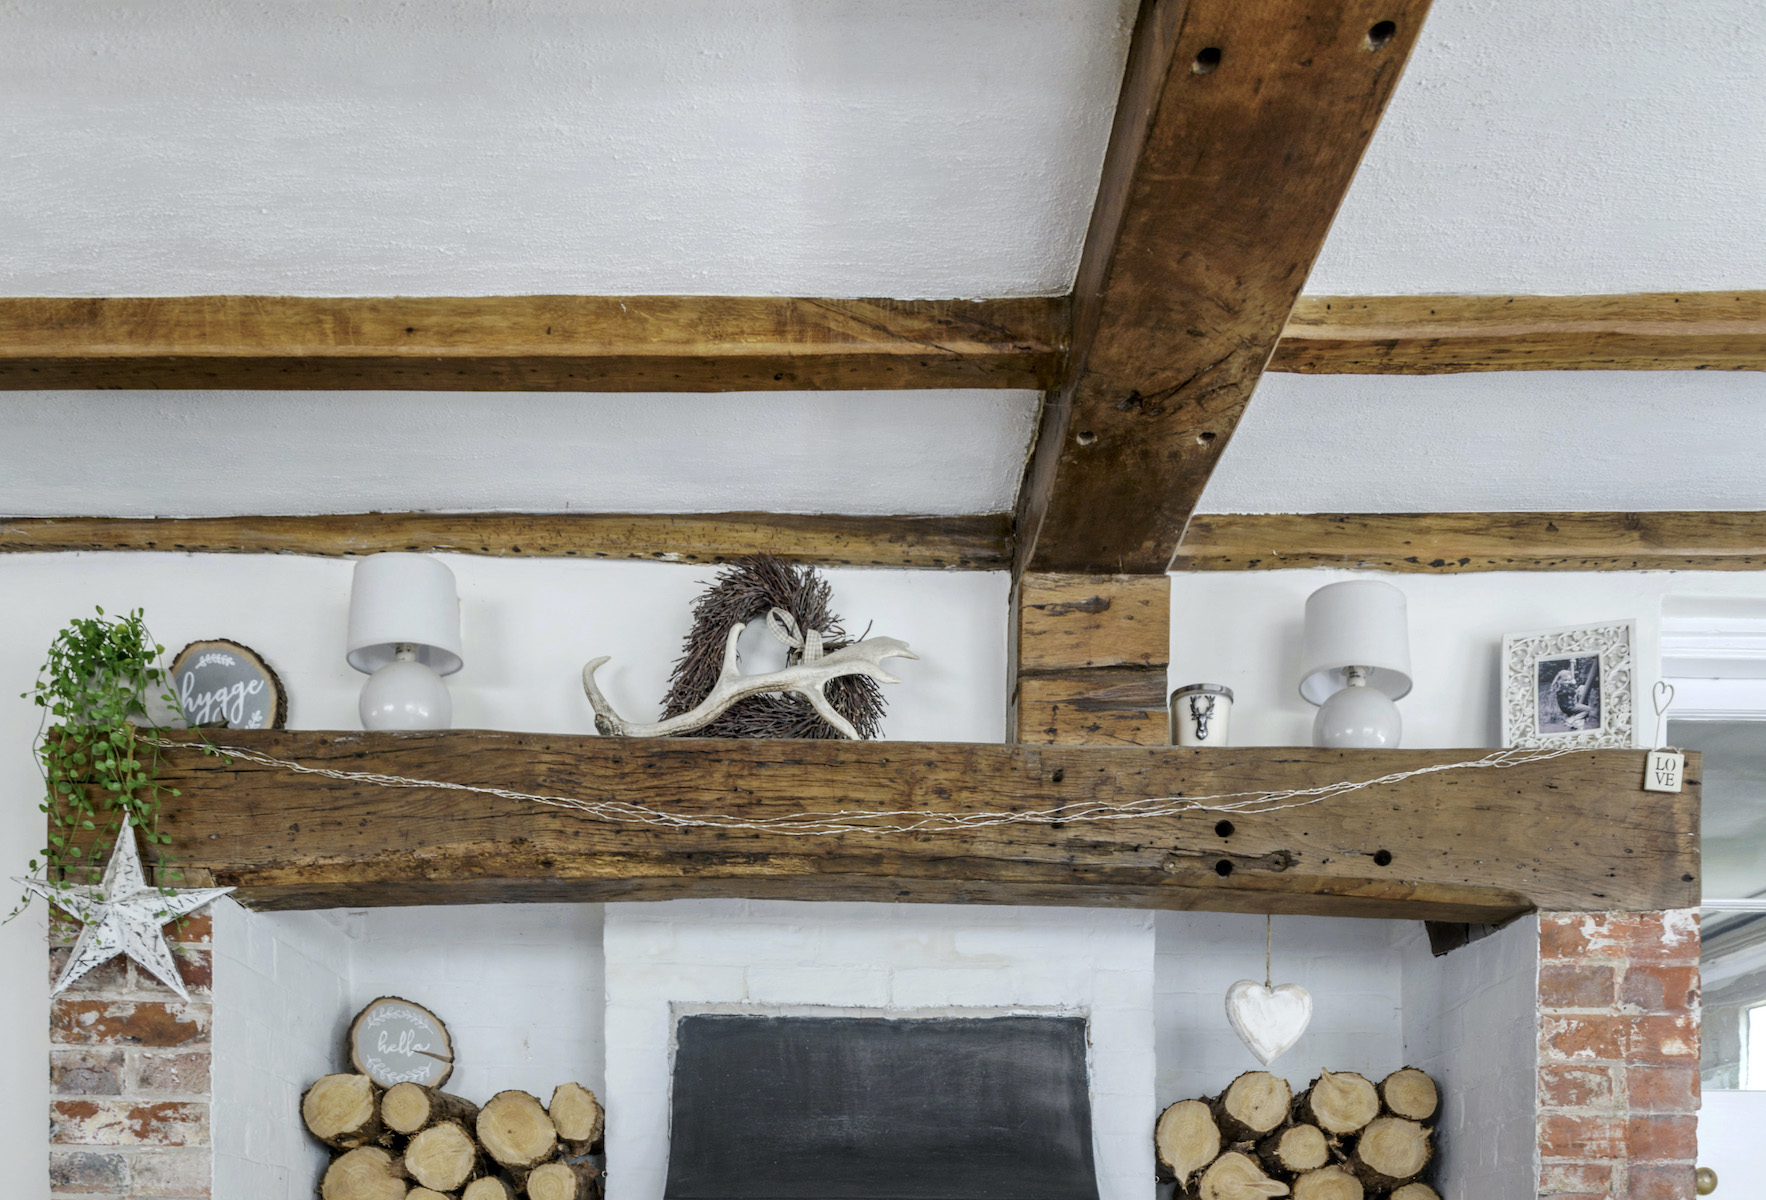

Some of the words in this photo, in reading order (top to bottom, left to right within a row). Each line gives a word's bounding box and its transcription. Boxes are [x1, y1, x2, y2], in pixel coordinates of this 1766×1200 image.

[182, 671, 264, 725] hygge
[1655, 756, 1676, 772] LO
[1655, 771, 1675, 787] VE
[378, 1028, 431, 1057] hello
